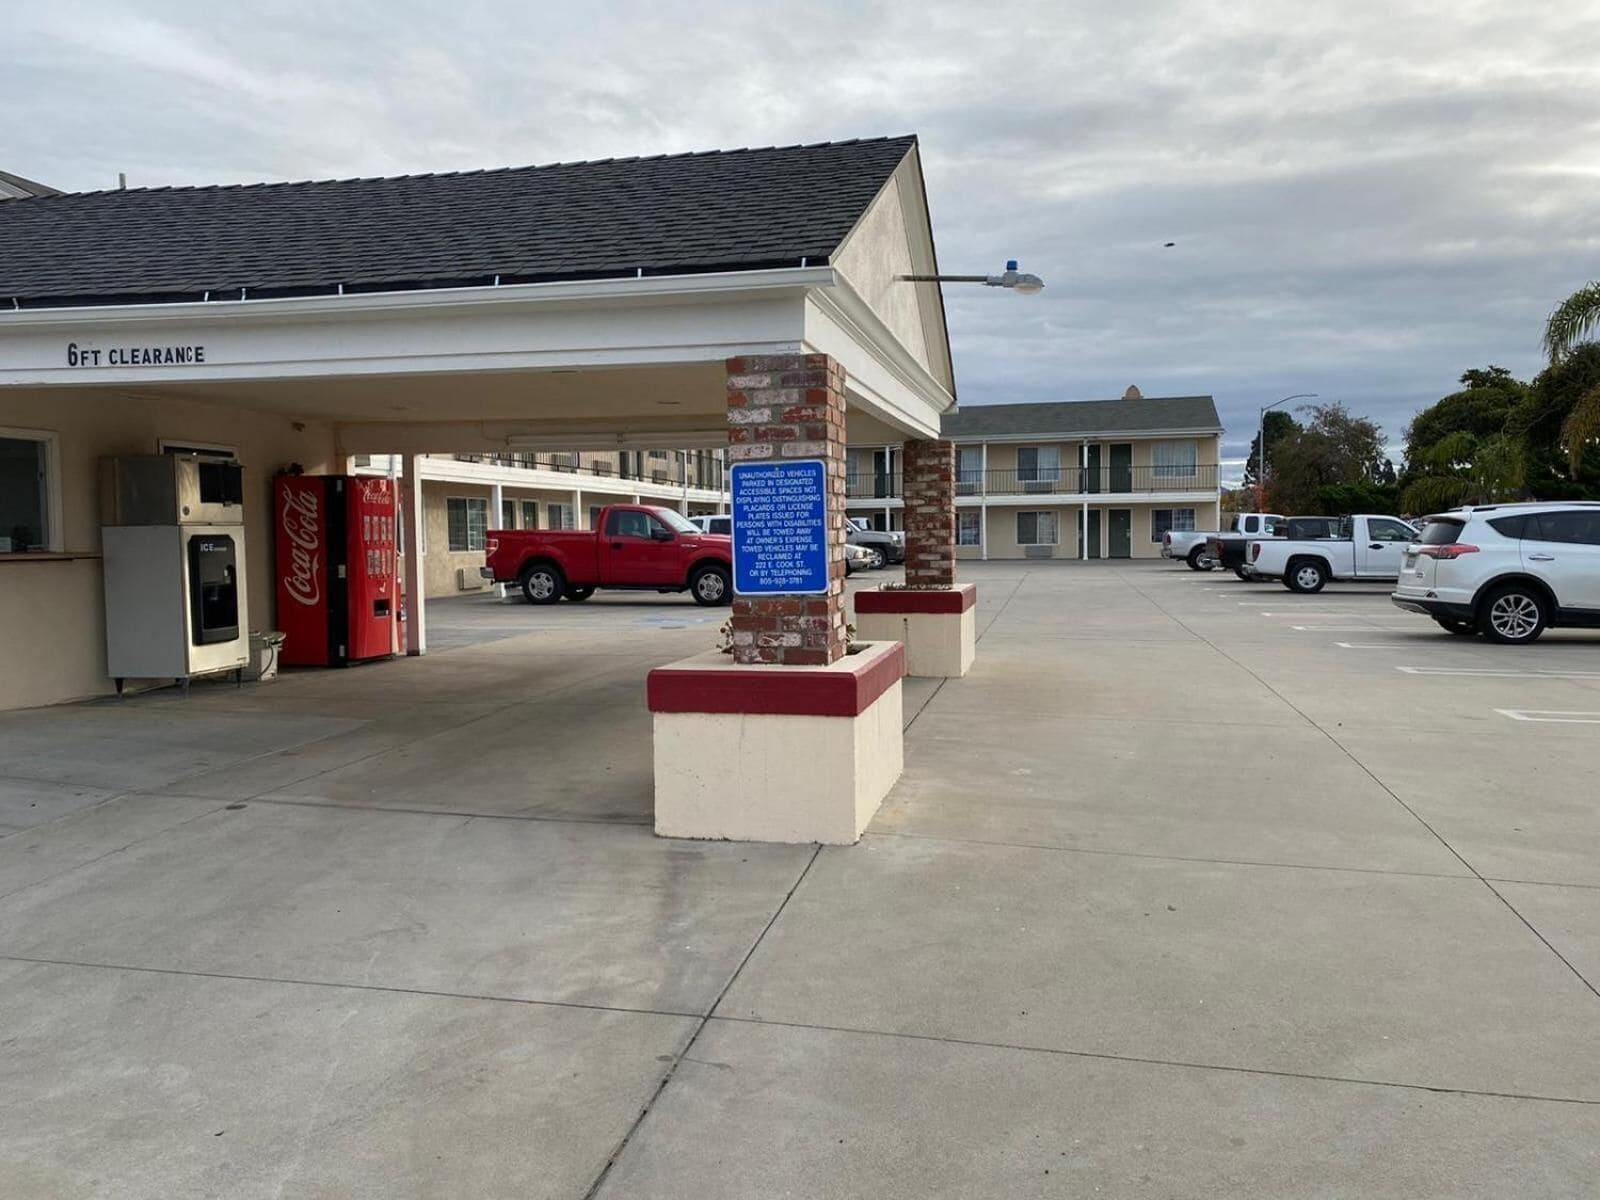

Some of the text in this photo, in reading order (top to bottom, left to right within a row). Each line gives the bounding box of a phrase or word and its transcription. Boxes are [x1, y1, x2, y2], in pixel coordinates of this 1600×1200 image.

[67, 342, 205, 366] 6FT CLEARANCE
[739, 469, 816, 479] UNAUTHORIZED VEHICLES
[736, 494, 821, 504] DISPLAYING DISTINGUISHING
[748, 512, 770, 520] PLATES
[784, 519, 821, 527] DISABILITIES
[200, 543, 214, 552] ICE
